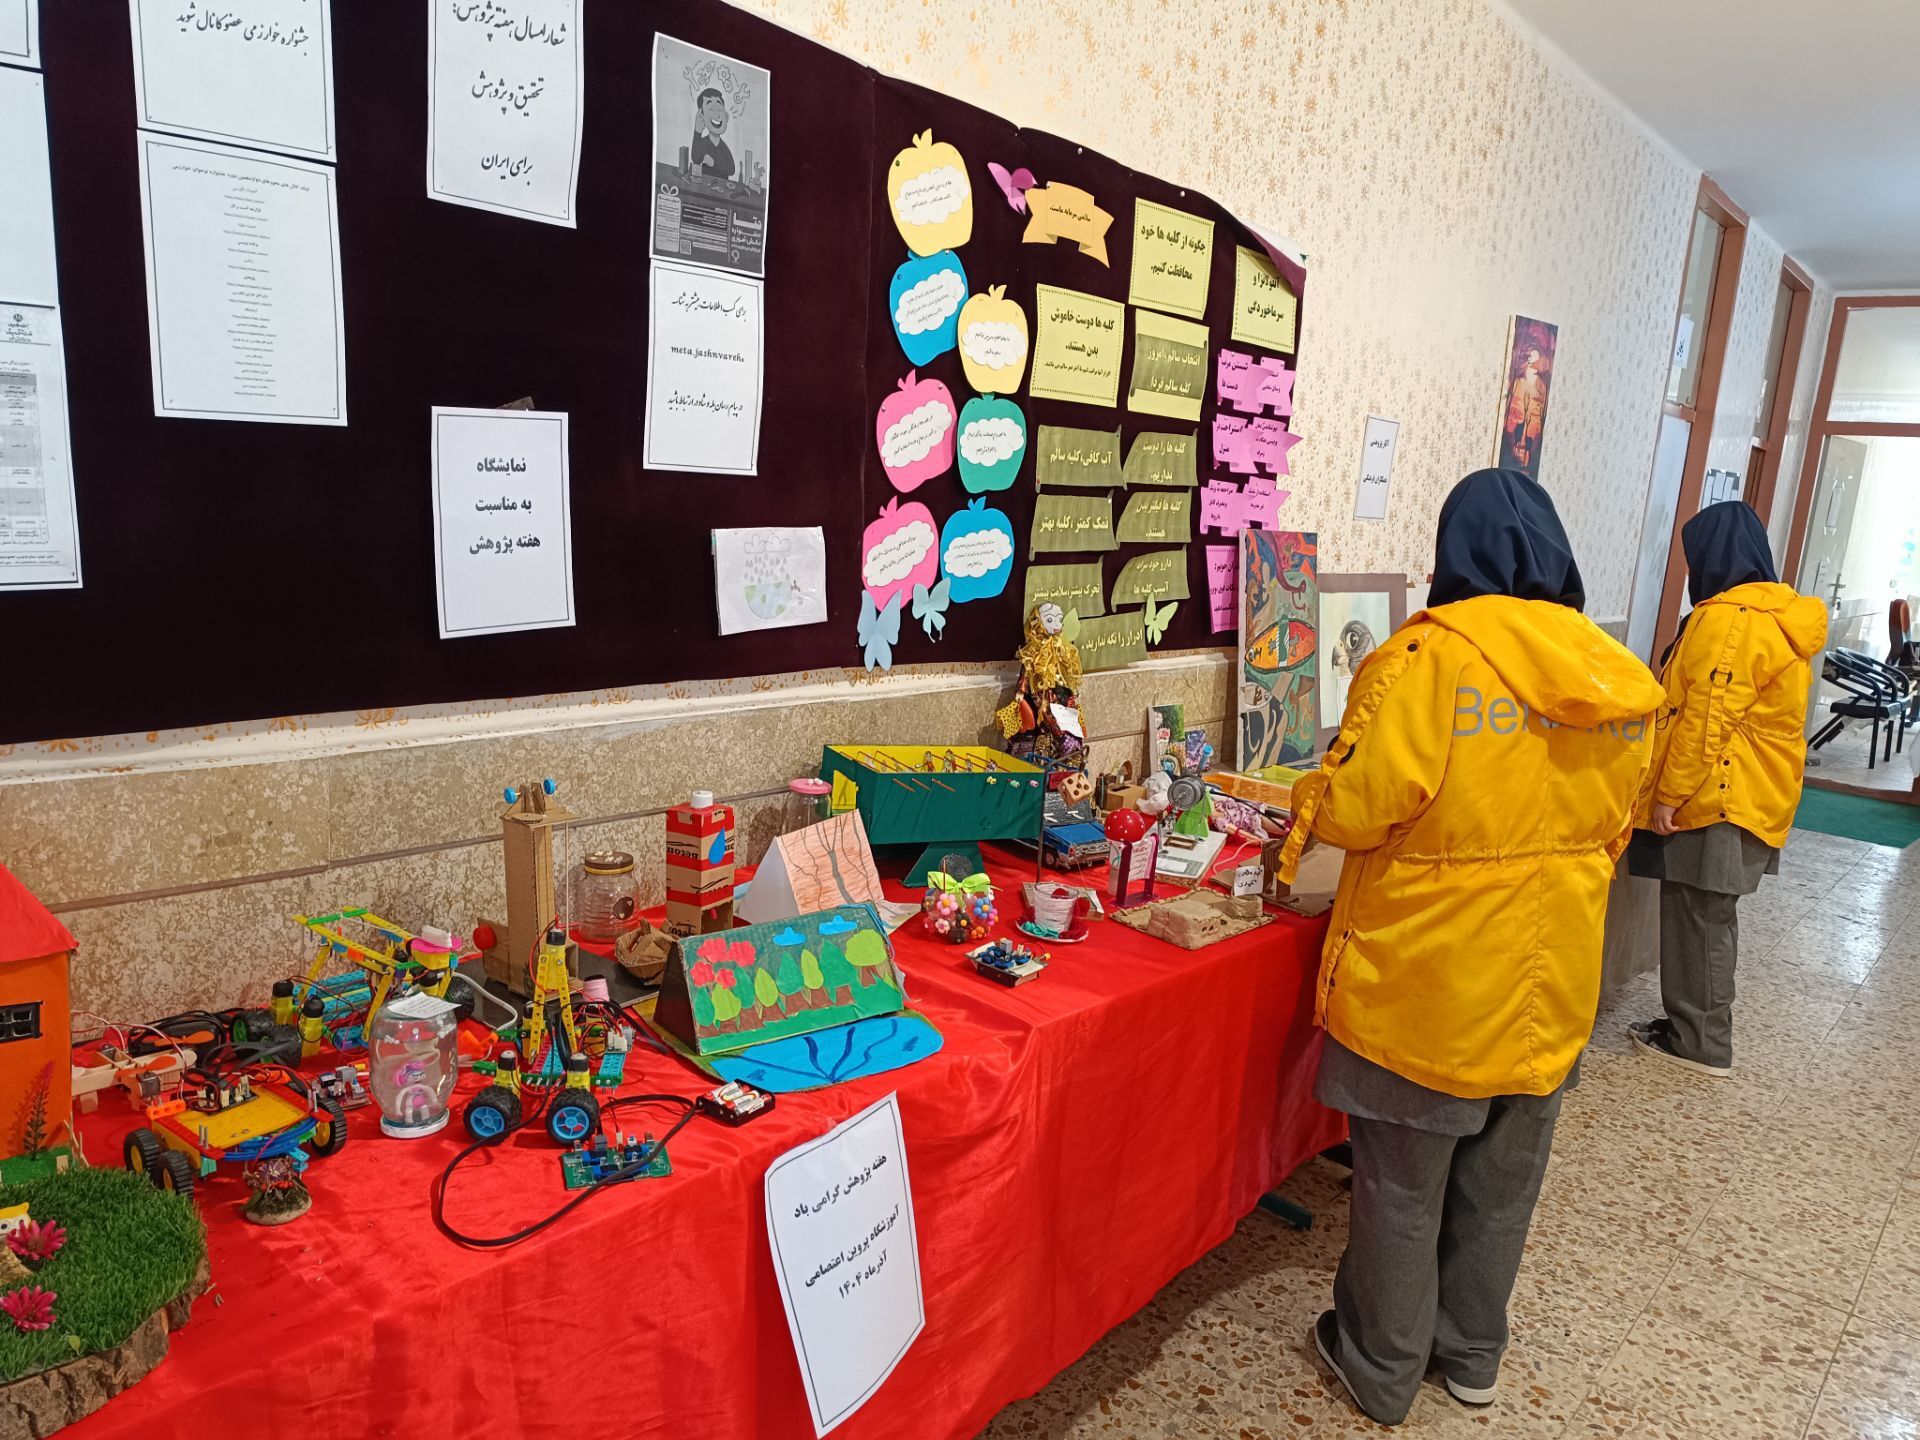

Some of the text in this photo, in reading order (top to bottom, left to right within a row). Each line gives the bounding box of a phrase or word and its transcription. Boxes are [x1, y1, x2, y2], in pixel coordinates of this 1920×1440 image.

[176, 2, 309, 56] جشنواره خوارزمی عضو کانال شوید
[494, 6, 514, 38] هفته
[514, 16, 546, 42] امسال
[543, 22, 566, 46] شعار
[471, 70, 544, 117] تحقیق و پژوهش
[480, 154, 534, 186] برای ایران
[1140, 224, 1154, 240] خود
[1156, 226, 1164, 240] ها
[1166, 230, 1180, 246] کلیه
[1180, 234, 1188, 250] از
[1168, 264, 1192, 280] محافظت
[700, 300, 722, 311] اطلاعات
[735, 305, 746, 322] برای
[1247, 300, 1284, 322] سرماخوردگی
[1050, 307, 1114, 332] کلیه ها دوست خاموش
[1086, 346, 1098, 358] بدن
[1168, 349, 1181, 364] سالم
[1182, 352, 1200, 366] انتخاب
[1150, 375, 1192, 395] کلیه سالم فردا
[667, 390, 678, 411] باشید
[1050, 447, 1066, 464] سالم
[1142, 440, 1186, 456] کلیه ها را دوست
[476, 456, 526, 476] نمایشگاه
[1100, 450, 1112, 468] آب
[475, 496, 532, 515] به مناسبت
[1147, 498, 1163, 514] فیلتر
[1162, 498, 1168, 510] ها
[1170, 500, 1182, 514] کلیه
[1039, 516, 1054, 532] بهتر
[1074, 516, 1091, 533] کمتر
[1092, 516, 1108, 530] نمک
[469, 532, 541, 555] هفته پژوهش
[1032, 586, 1050, 602] بیشتر
[1083, 584, 1100, 598] تحرک
[1133, 581, 1169, 596] آسیب کلیه ها
[1118, 631, 1125, 648] را
[1126, 628, 1143, 646] ادرار
[794, 1154, 888, 1218] هفته پژوهش گرامی باد
[805, 1202, 900, 1288] آموزشگاه پروین اعتصامی
[838, 1248, 887, 1299] آذرماه ۱۴۰۴
